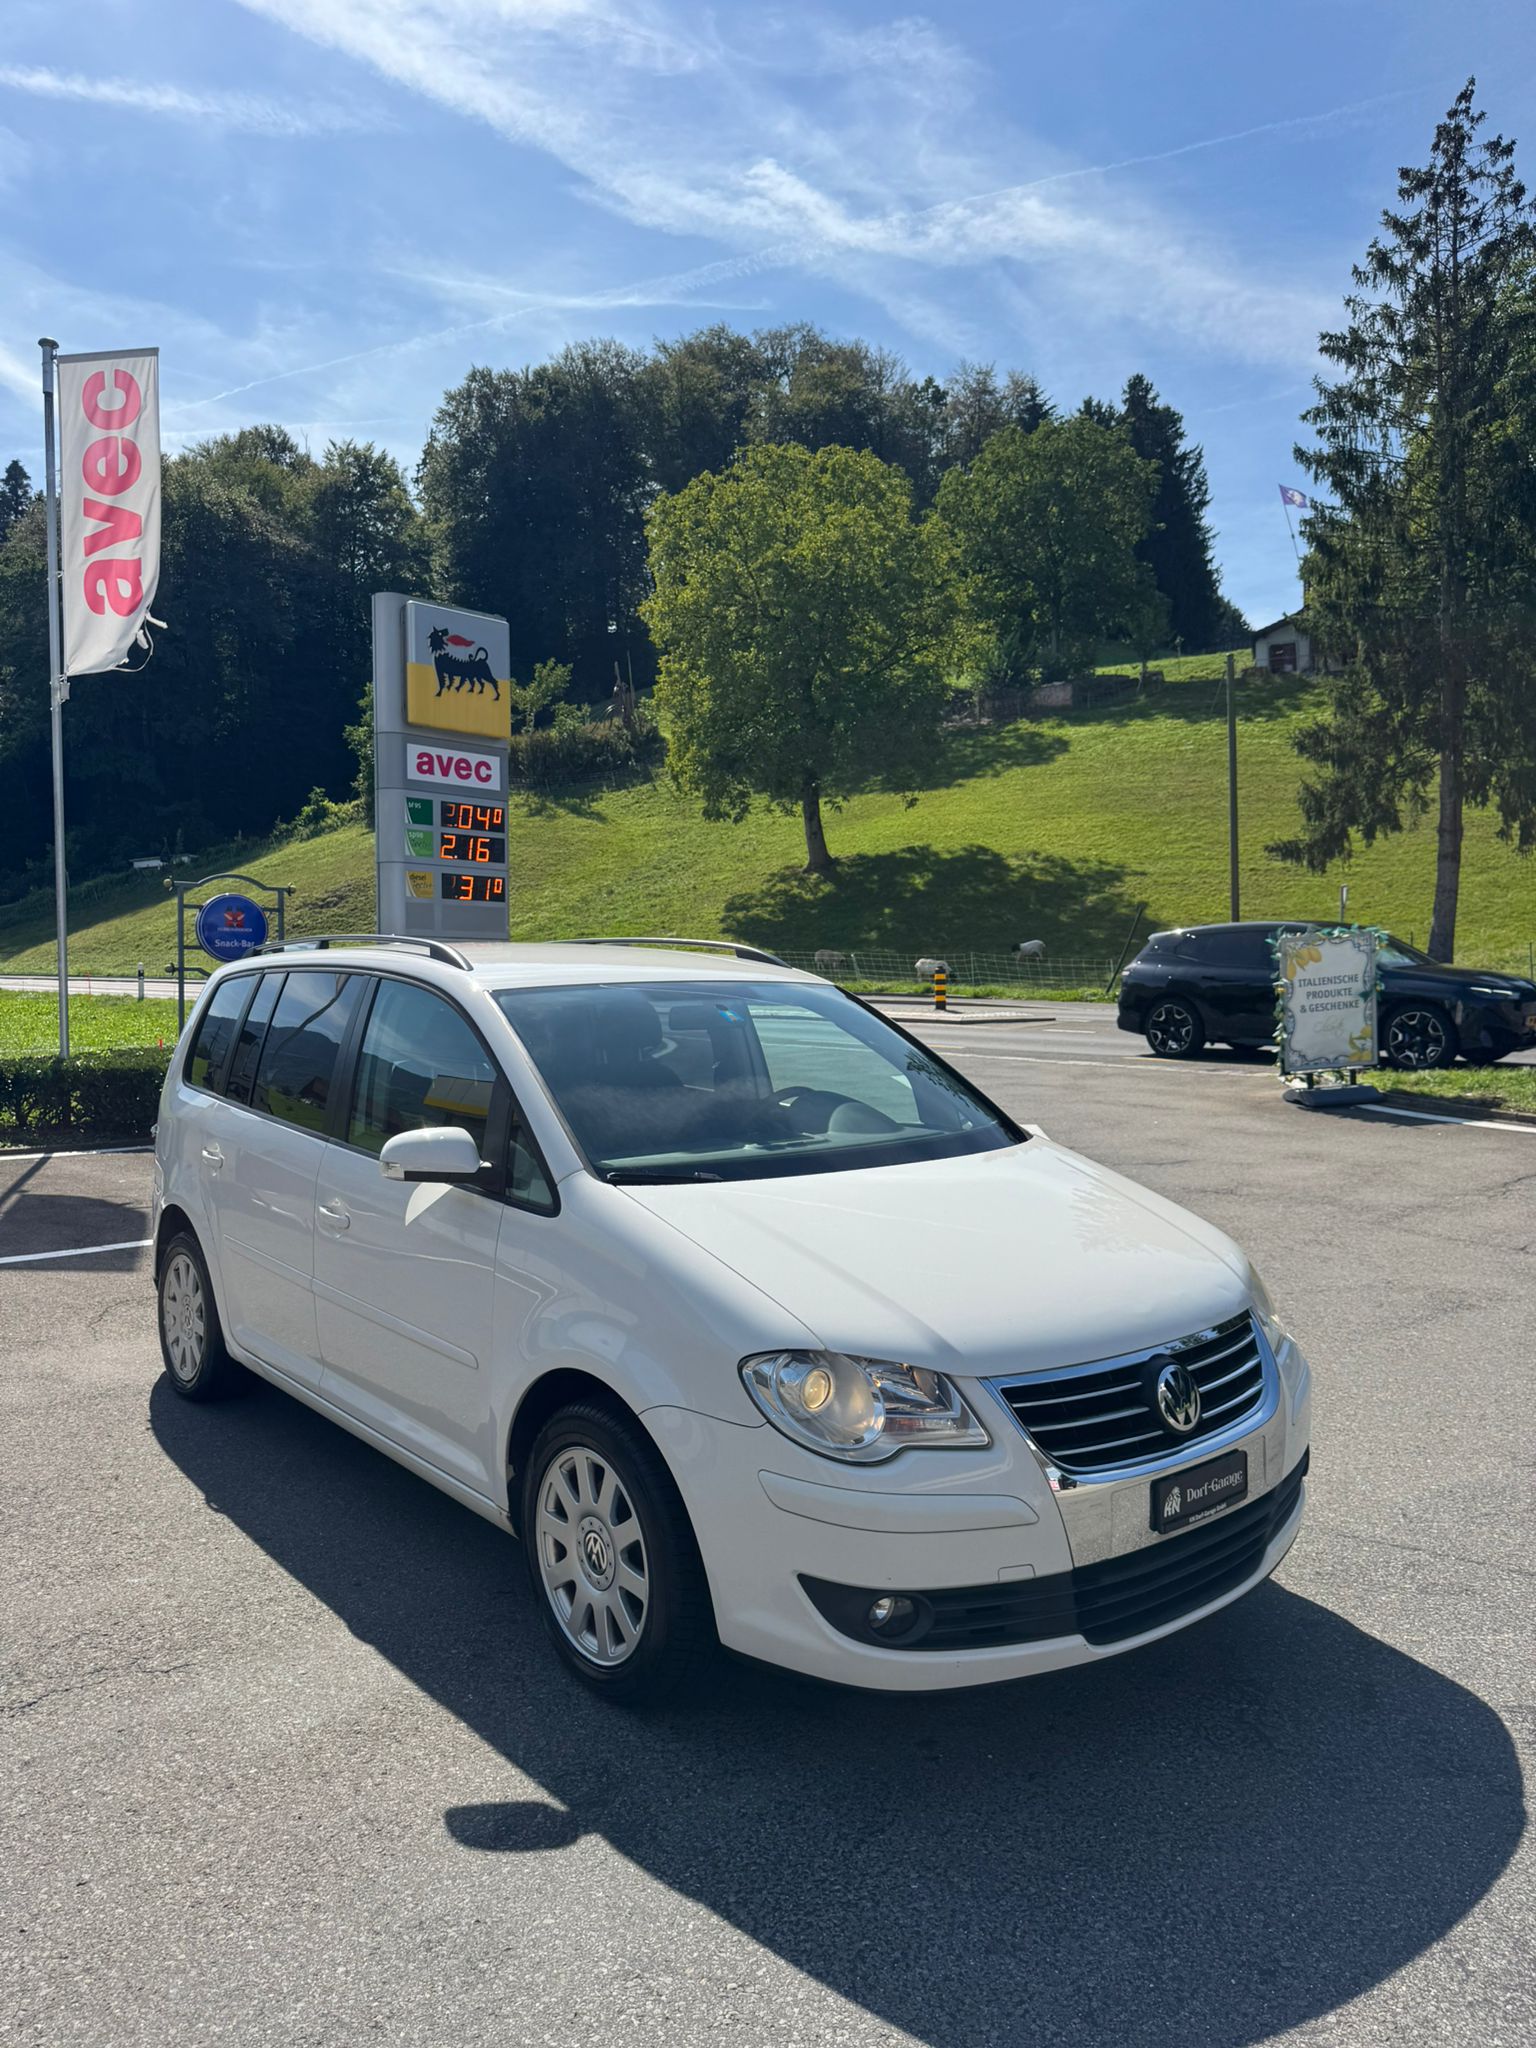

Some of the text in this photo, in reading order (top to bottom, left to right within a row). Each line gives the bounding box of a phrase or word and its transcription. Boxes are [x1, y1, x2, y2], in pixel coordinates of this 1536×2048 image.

[82, 369, 144, 617] avec
[416, 752, 492, 783] avec
[214, 939, 256, 948] Snack-Bar
[1298, 974, 1360, 988] ITALIENISCHE
[1306, 987, 1353, 1000] PRODUKTE
[1300, 1000, 1361, 1014] & GESCHENKE
[1187, 1470, 1243, 1503] Dorf-Garage
